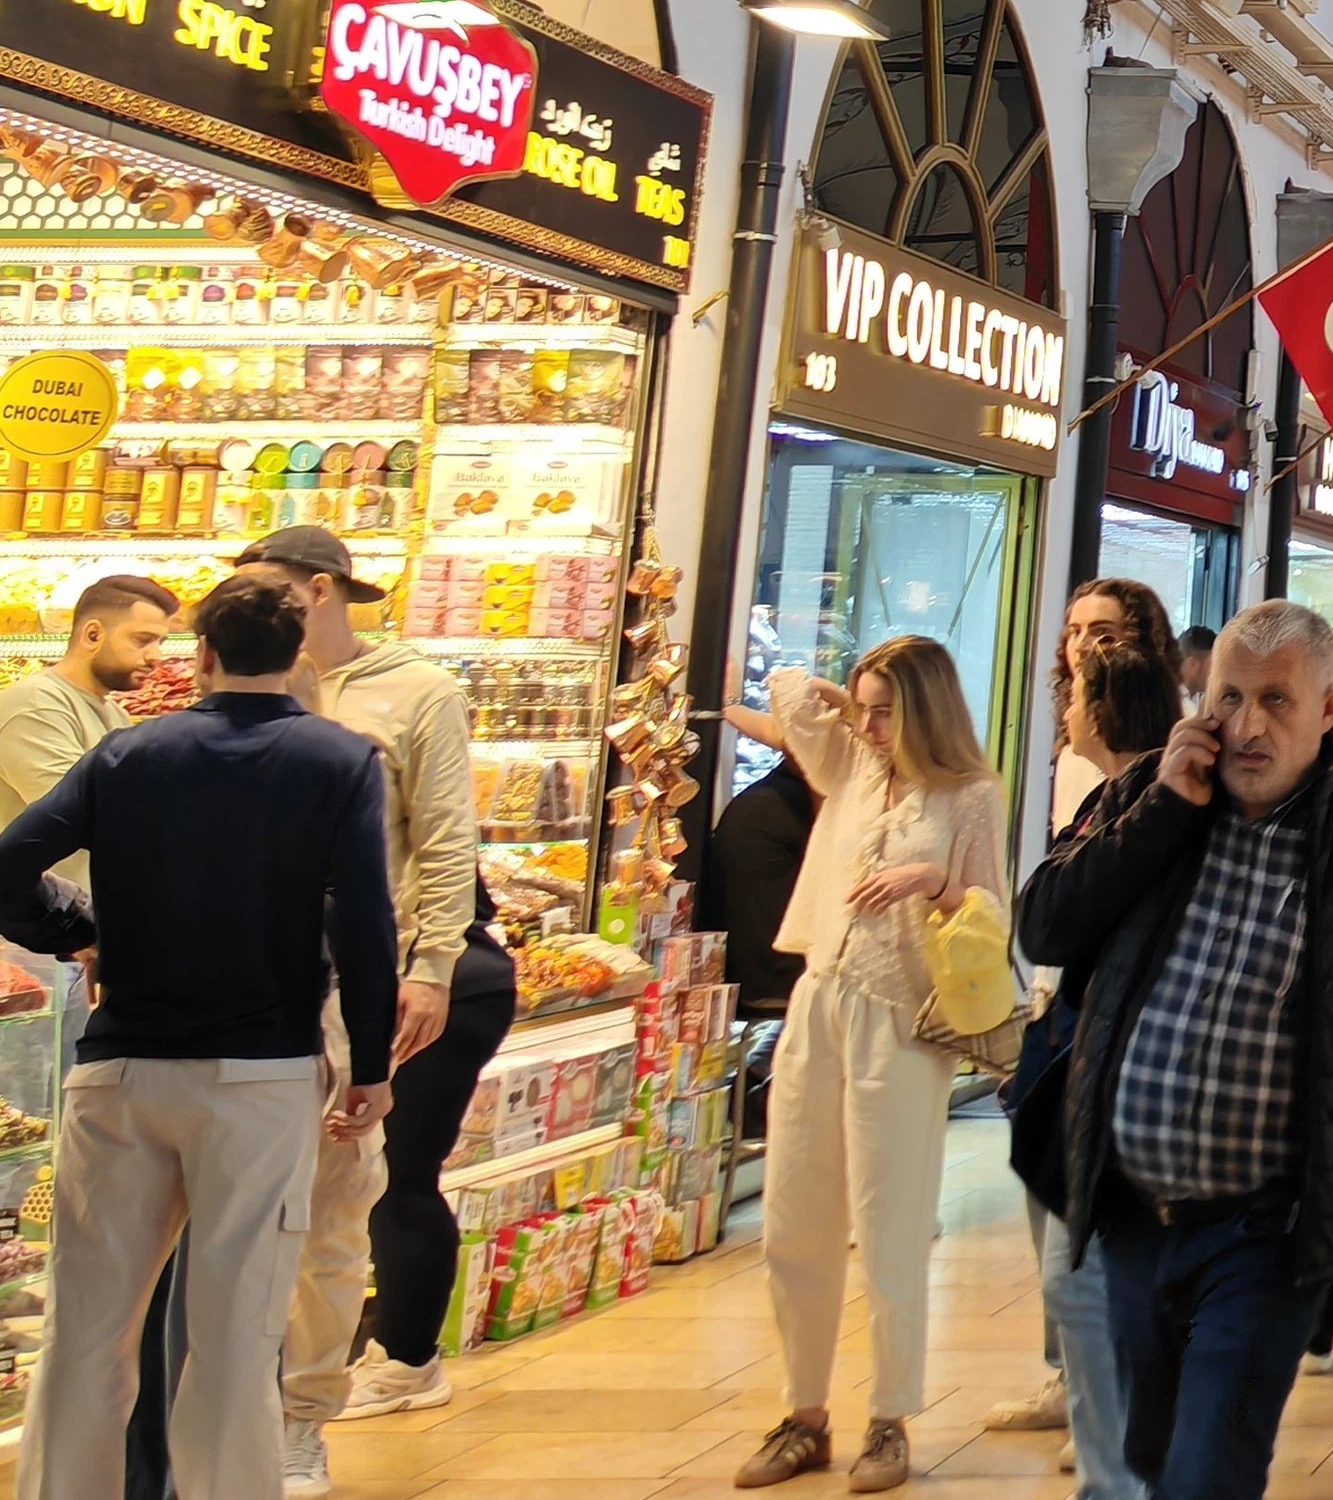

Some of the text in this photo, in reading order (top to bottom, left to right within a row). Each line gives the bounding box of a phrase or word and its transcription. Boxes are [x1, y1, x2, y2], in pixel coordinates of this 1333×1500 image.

[331, 2, 526, 128] ÇAVUŞBEY
[358, 88, 496, 167] Turkish Delight
[523, 131, 686, 227] ROSE OIL TEAS
[826, 248, 1064, 407] VIP COLLECTION
[3, 404, 102, 426] CHOCOLATE
[32, 379, 84, 397] DUBAI
[456, 471, 506, 484] Baklava
